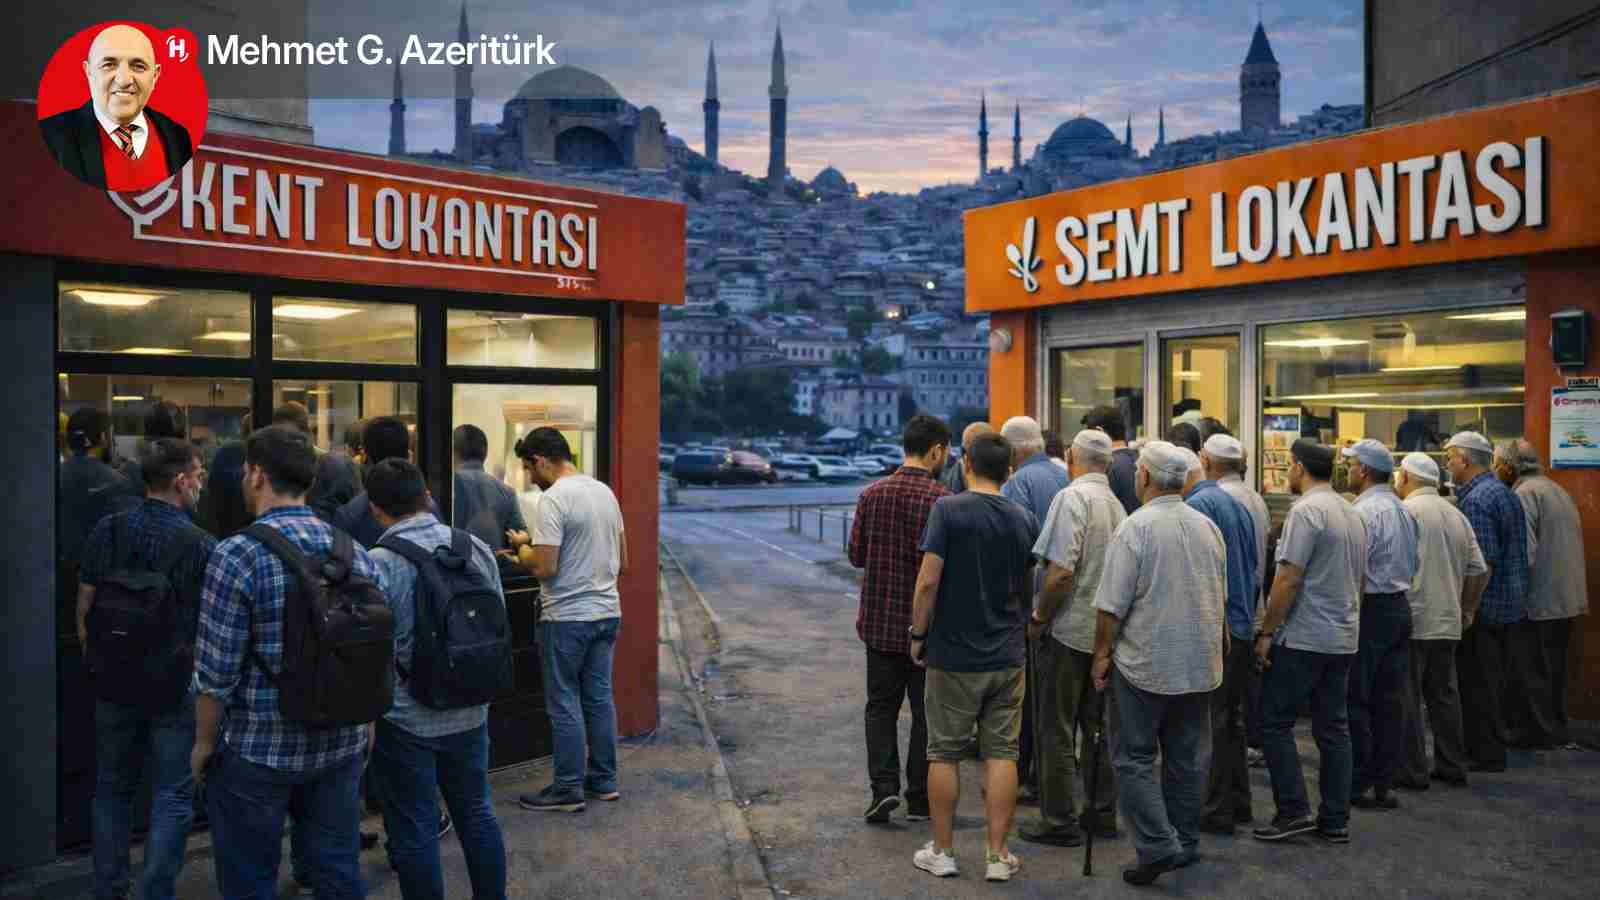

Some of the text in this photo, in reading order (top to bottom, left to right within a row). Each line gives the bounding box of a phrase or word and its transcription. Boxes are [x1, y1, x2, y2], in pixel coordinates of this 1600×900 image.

[181, 158, 598, 270] KENT LOKANTASI
[1055, 135, 1546, 286] SEMT LOKANTASI
